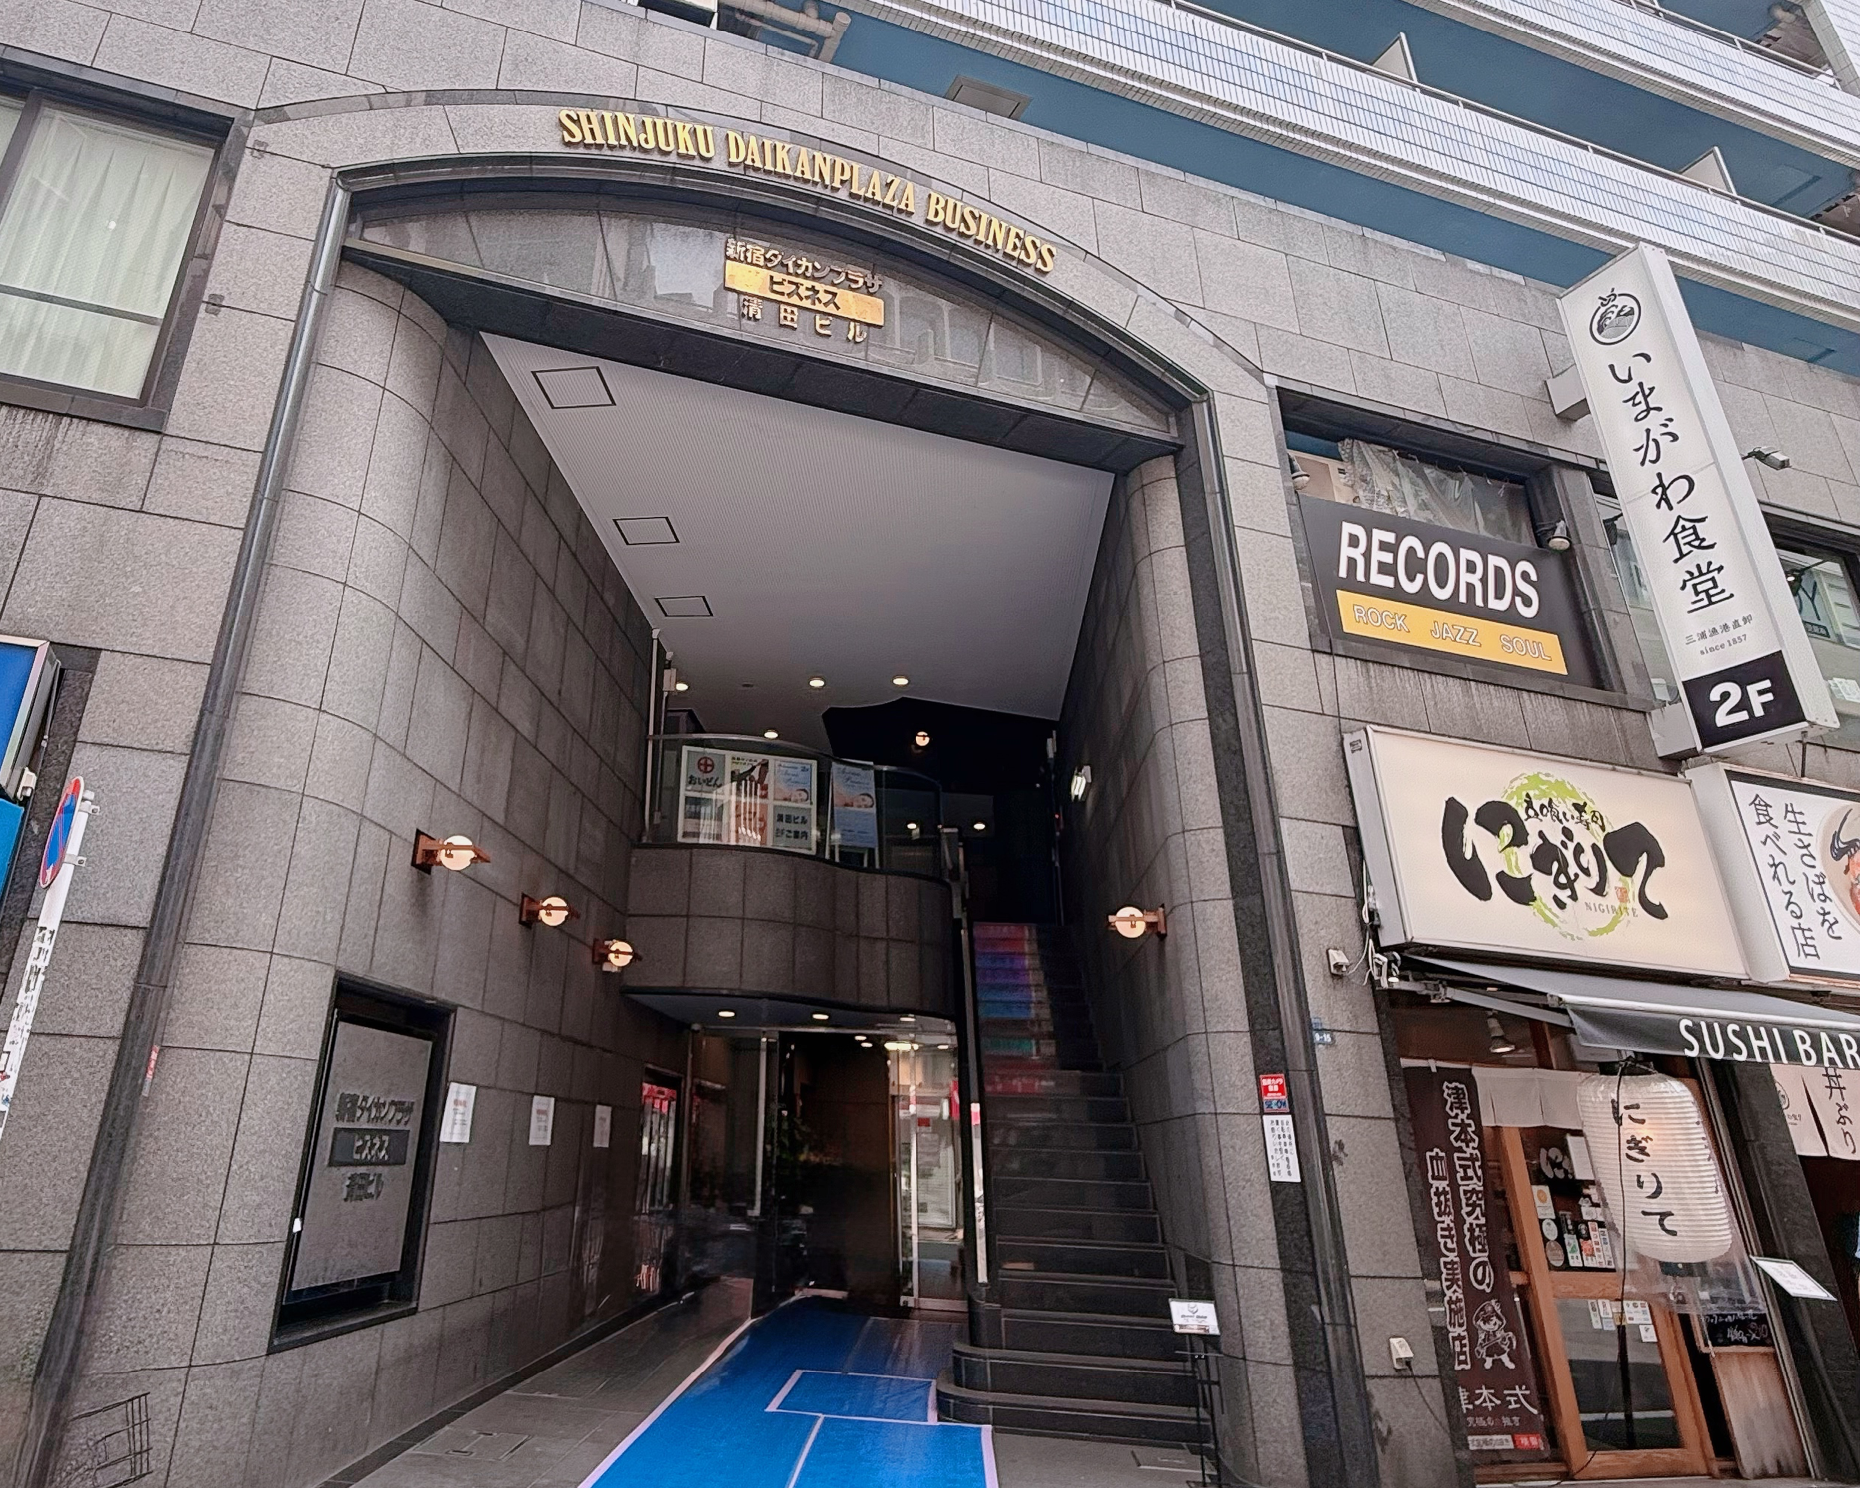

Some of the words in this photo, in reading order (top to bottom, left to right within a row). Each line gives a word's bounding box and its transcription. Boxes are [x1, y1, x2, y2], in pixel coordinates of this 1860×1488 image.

[559, 109, 716, 160] SHINJUKU
[727, 131, 916, 213] DAIKANPLAZA
[926, 191, 1058, 273] BUSINESS
[1607, 352, 1734, 615] いまがわ食堂
[1337, 521, 1540, 618] RECORDS
[1353, 603, 1410, 634] ROCK
[1430, 619, 1482, 648] JAZZ
[1500, 635, 1552, 662] SOUL
[1700, 641, 1726, 655] since
[1727, 633, 1748, 647] 1857
[1709, 679, 1774, 728] 2F
[1442, 796, 1668, 920] にぎりて
[1584, 902, 1639, 918] NIGIRITE
[1749, 793, 1820, 960] 食べれる店
[1784, 802, 1842, 940] 生さばを
[1679, 1018, 1788, 1064] SUSHI
[1792, 1029, 1860, 1069] BAR
[1611, 1098, 1678, 1237] にぎりて
